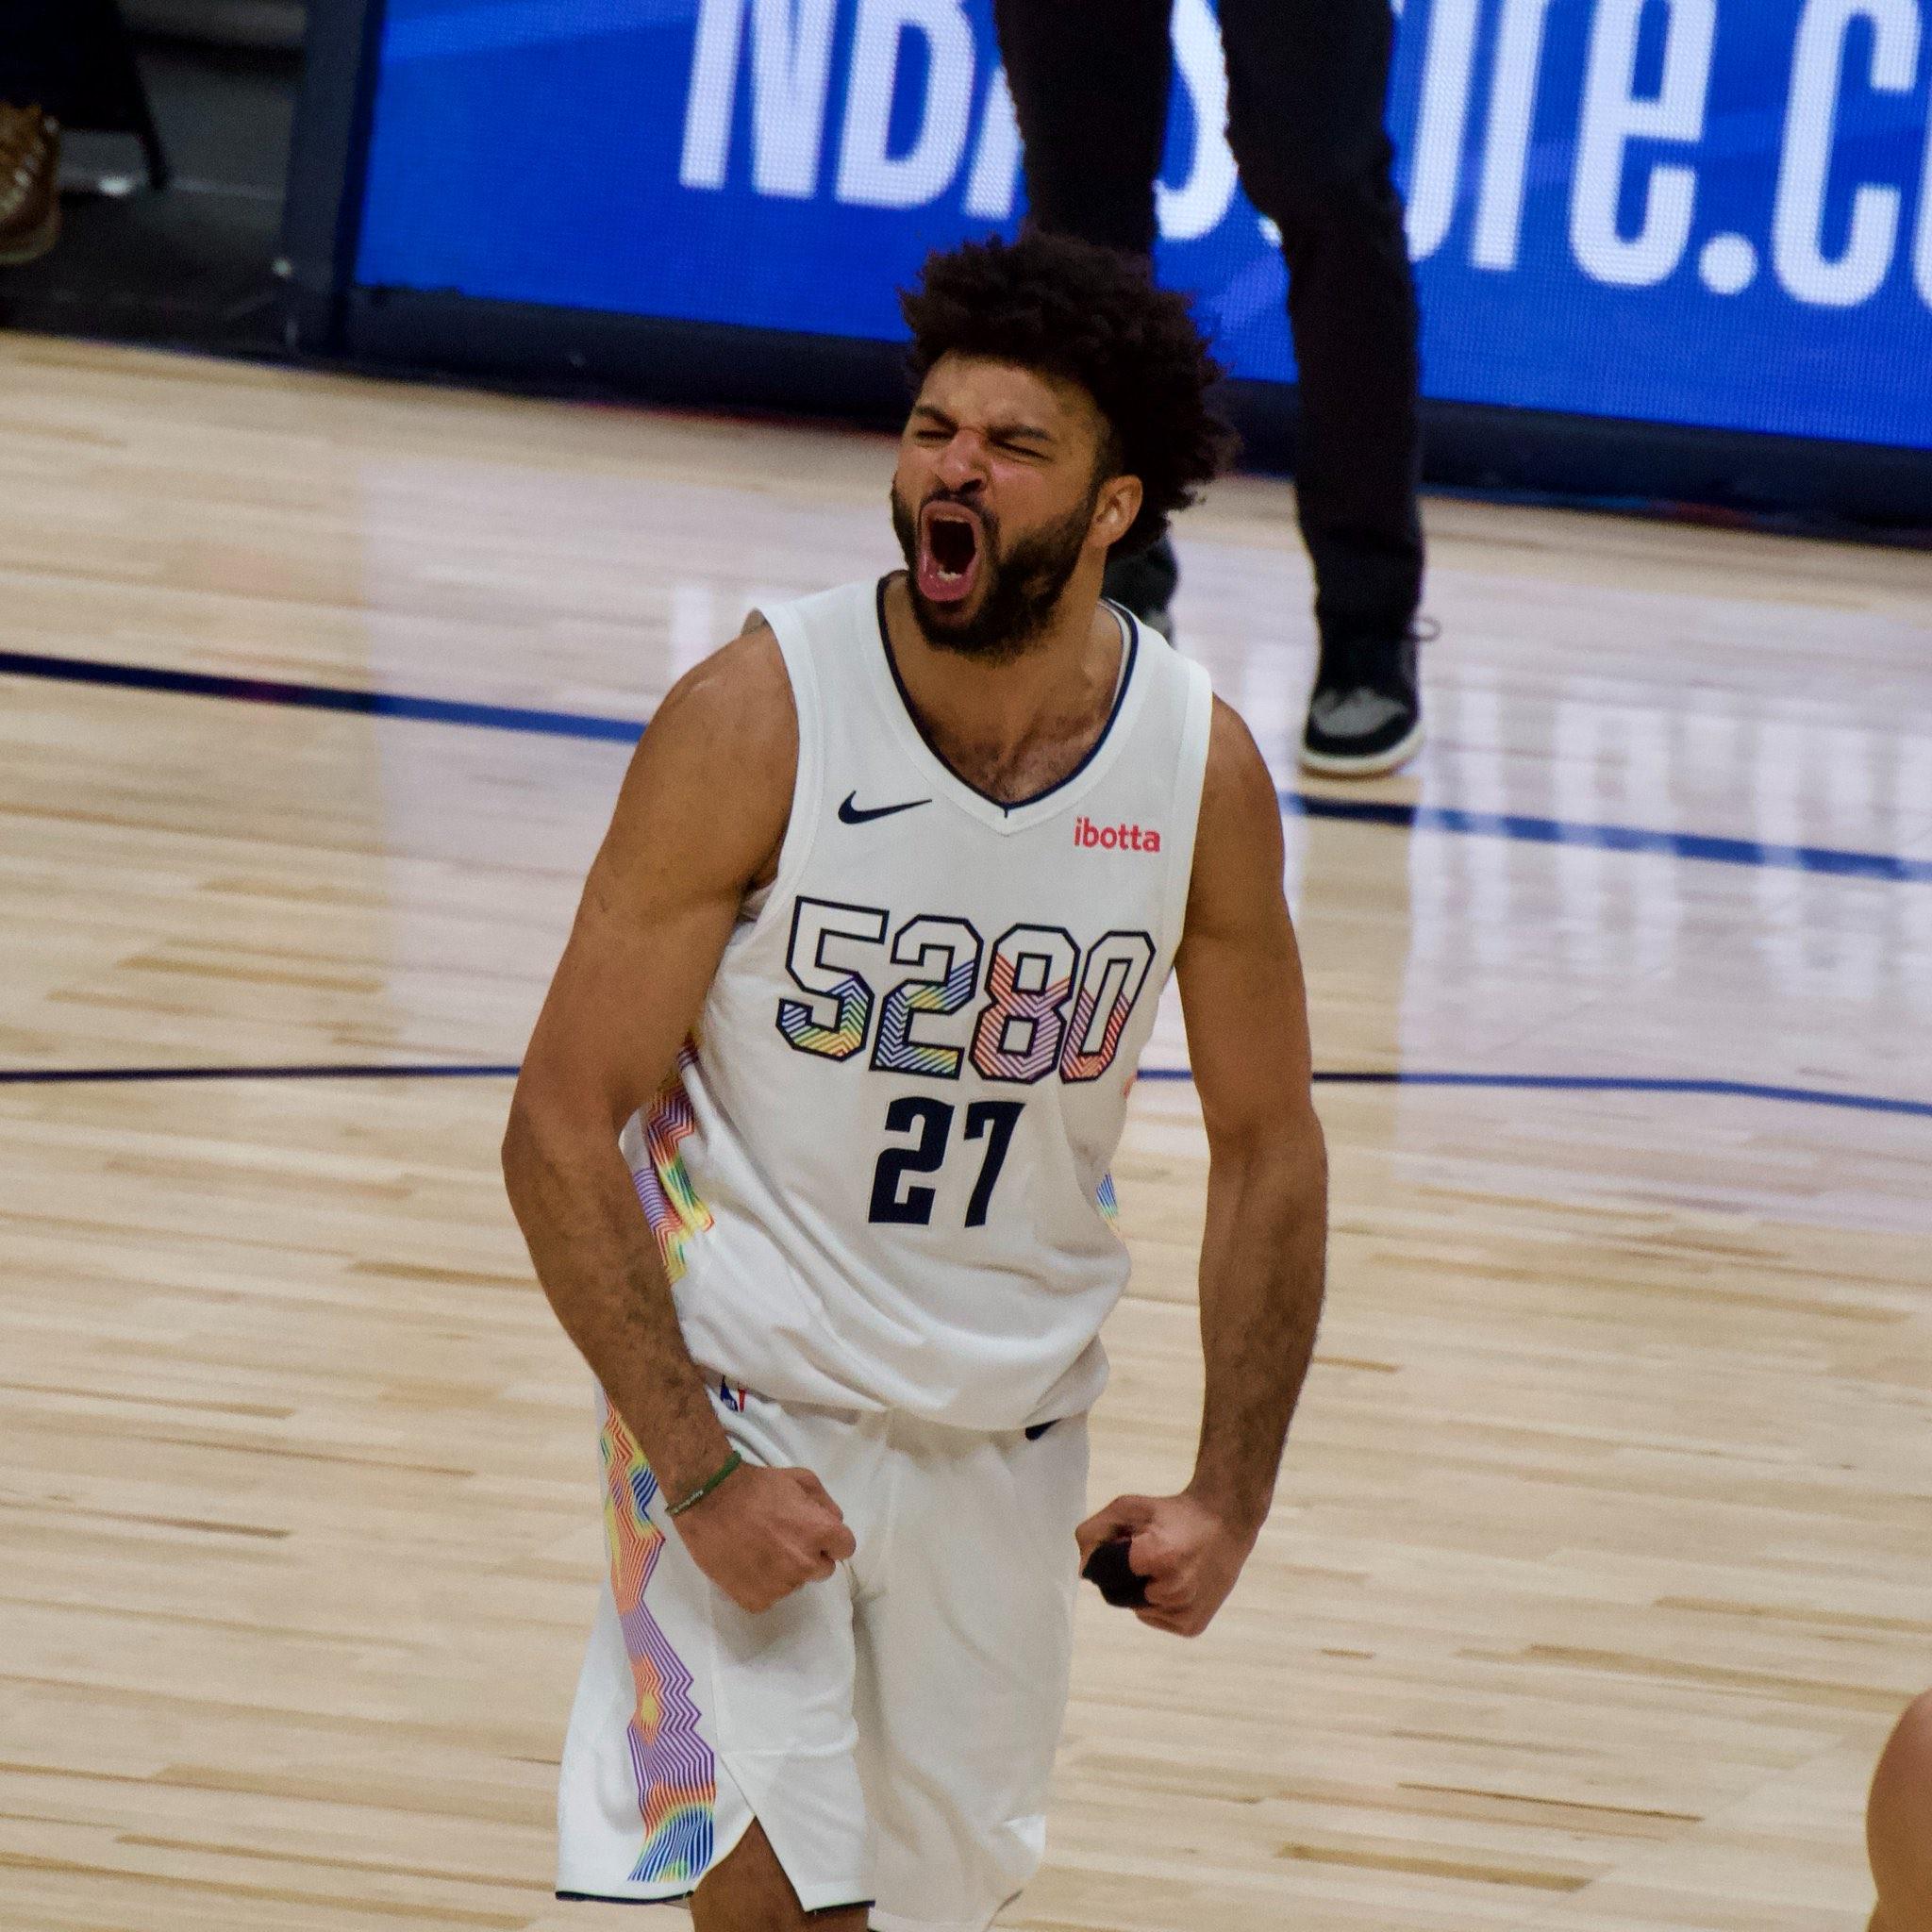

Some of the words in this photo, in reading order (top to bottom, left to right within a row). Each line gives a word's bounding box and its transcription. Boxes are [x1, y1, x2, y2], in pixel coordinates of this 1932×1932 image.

[1074, 816, 1160, 852] ibotta
[775, 895, 1157, 1084] 5280
[868, 1096, 1025, 1227] 27
